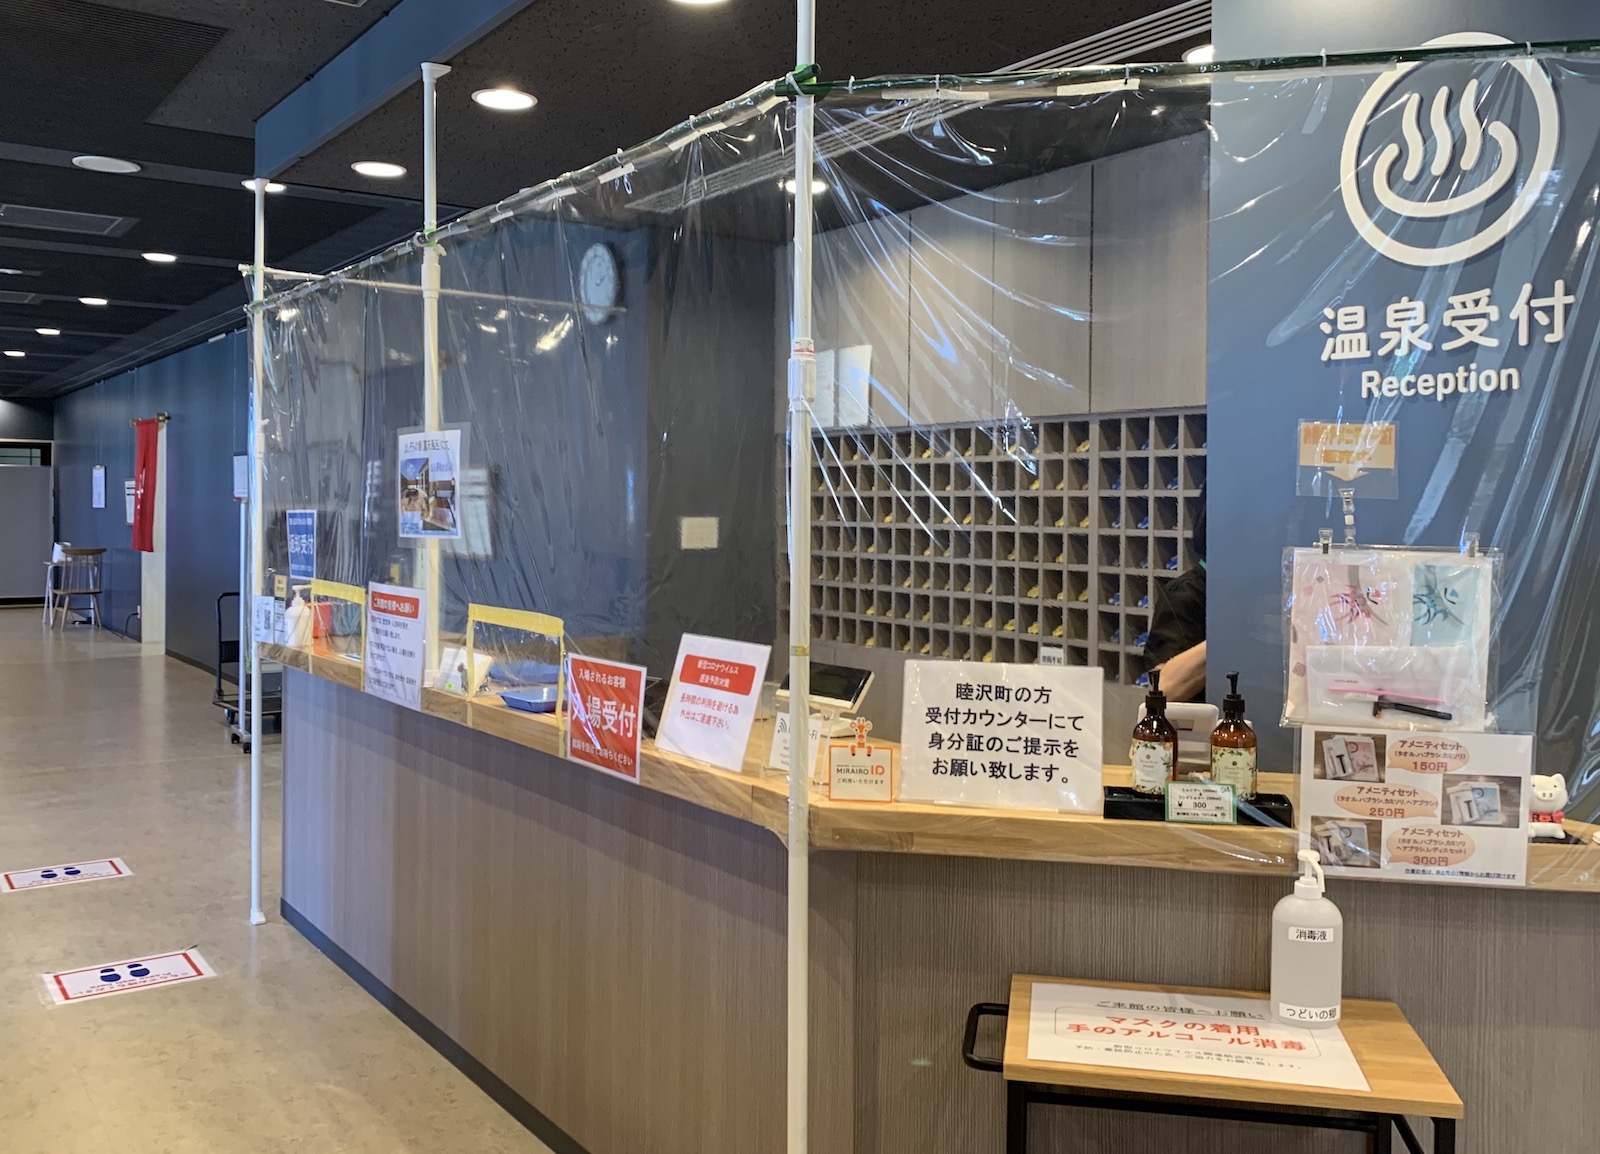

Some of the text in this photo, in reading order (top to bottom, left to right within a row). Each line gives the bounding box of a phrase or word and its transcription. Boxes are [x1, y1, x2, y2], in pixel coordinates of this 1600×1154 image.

[1319, 279, 1576, 362] 温泉受付
[1360, 363, 1521, 401] Reception
[697, 659, 739, 675] 新型コロナウイルス
[578, 667, 627, 689] 入場されるお客様
[698, 673, 731, 688] 感染予防対策
[955, 682, 1053, 704] 睦沢町の方
[679, 692, 739, 716] 長時間の利用を避ける為
[924, 706, 1085, 732] 受付カウンターにて
[928, 731, 1080, 759] 身分証のご提示を
[1398, 740, 1462, 751] アメニティセット
[870, 765, 885, 776] ID
[931, 757, 1070, 785] お願い致します。
[1412, 761, 1448, 772] 150円
[836, 777, 884, 785] ご利用いただけます
[1356, 786, 1419, 797] アメニティセット
[1192, 801, 1207, 809] 300
[1369, 807, 1405, 818] 250円
[1401, 827, 1464, 838] アメニティセット
[1412, 855, 1449, 866] 300円
[1295, 928, 1328, 941] 消毒液
[1095, 999, 1266, 1021] ご来館の皆様へお願い
[1104, 1015, 1261, 1037] マスクの着用
[1065, 1022, 1308, 1052] 手のアルコール消毒
